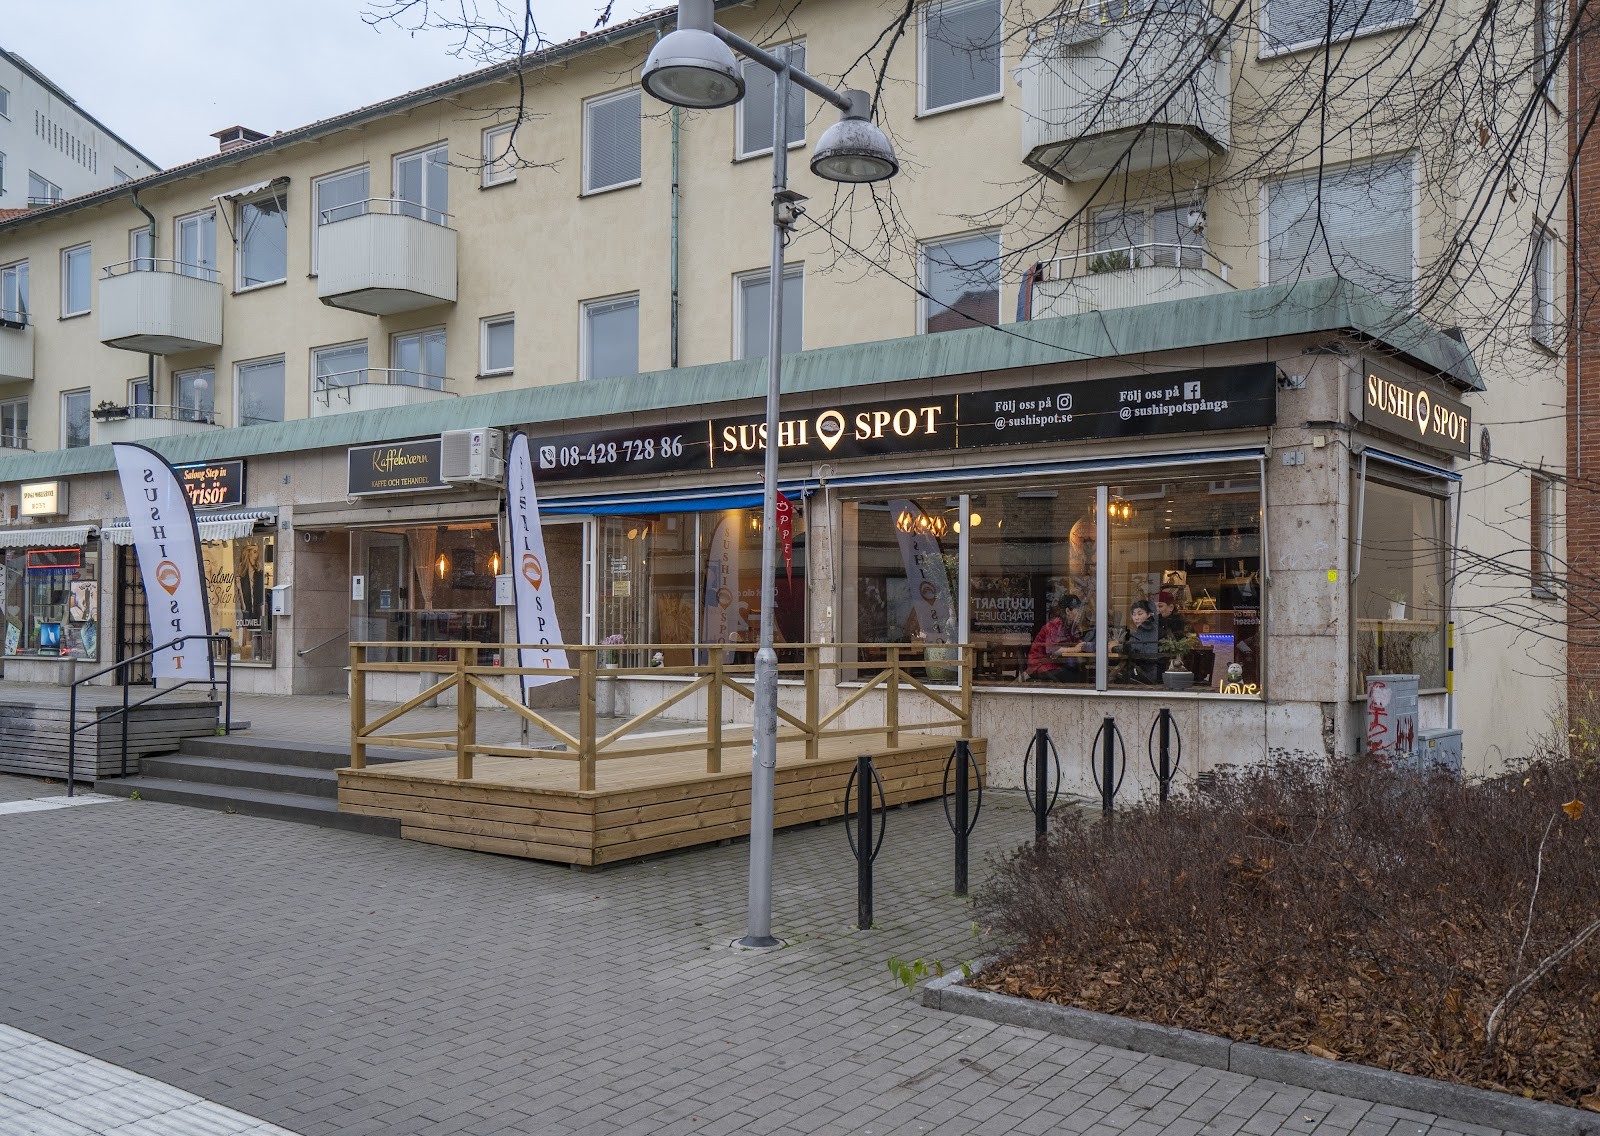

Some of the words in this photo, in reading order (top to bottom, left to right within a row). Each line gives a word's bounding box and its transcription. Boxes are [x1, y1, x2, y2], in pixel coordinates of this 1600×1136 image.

[1119, 389, 1142, 403] Följ
[1145, 390, 1163, 400] oss
[1165, 385, 1180, 401] på
[995, 400, 1016, 413] Följ
[1019, 401, 1035, 410] oss
[1038, 396, 1052, 411] på
[1120, 406, 1132, 420] @
[1134, 399, 1229, 417] sushispotspånga
[1368, 374, 1414, 422] SUSHI
[1433, 404, 1468, 444] SPOT
[723, 419, 809, 452] SUSHI
[855, 406, 942, 441] SPOT
[994, 416, 1007, 430] @
[1008, 413, 1073, 427] sushispot.se
[560, 442, 617, 467] 08-428
[622, 438, 655, 462] 728
[660, 435, 683, 458] 86
[183, 469, 206, 481] Salong
[205, 468, 219, 480] Step
[220, 467, 227, 477] in
[371, 479, 388, 488] KAFFE
[388, 478, 400, 487] OCH
[401, 476, 430, 486] TEHANDEL
[185, 481, 228, 505] Frisör
[535, 596, 552, 668] SPOT
[1219, 679, 1261, 695] love
